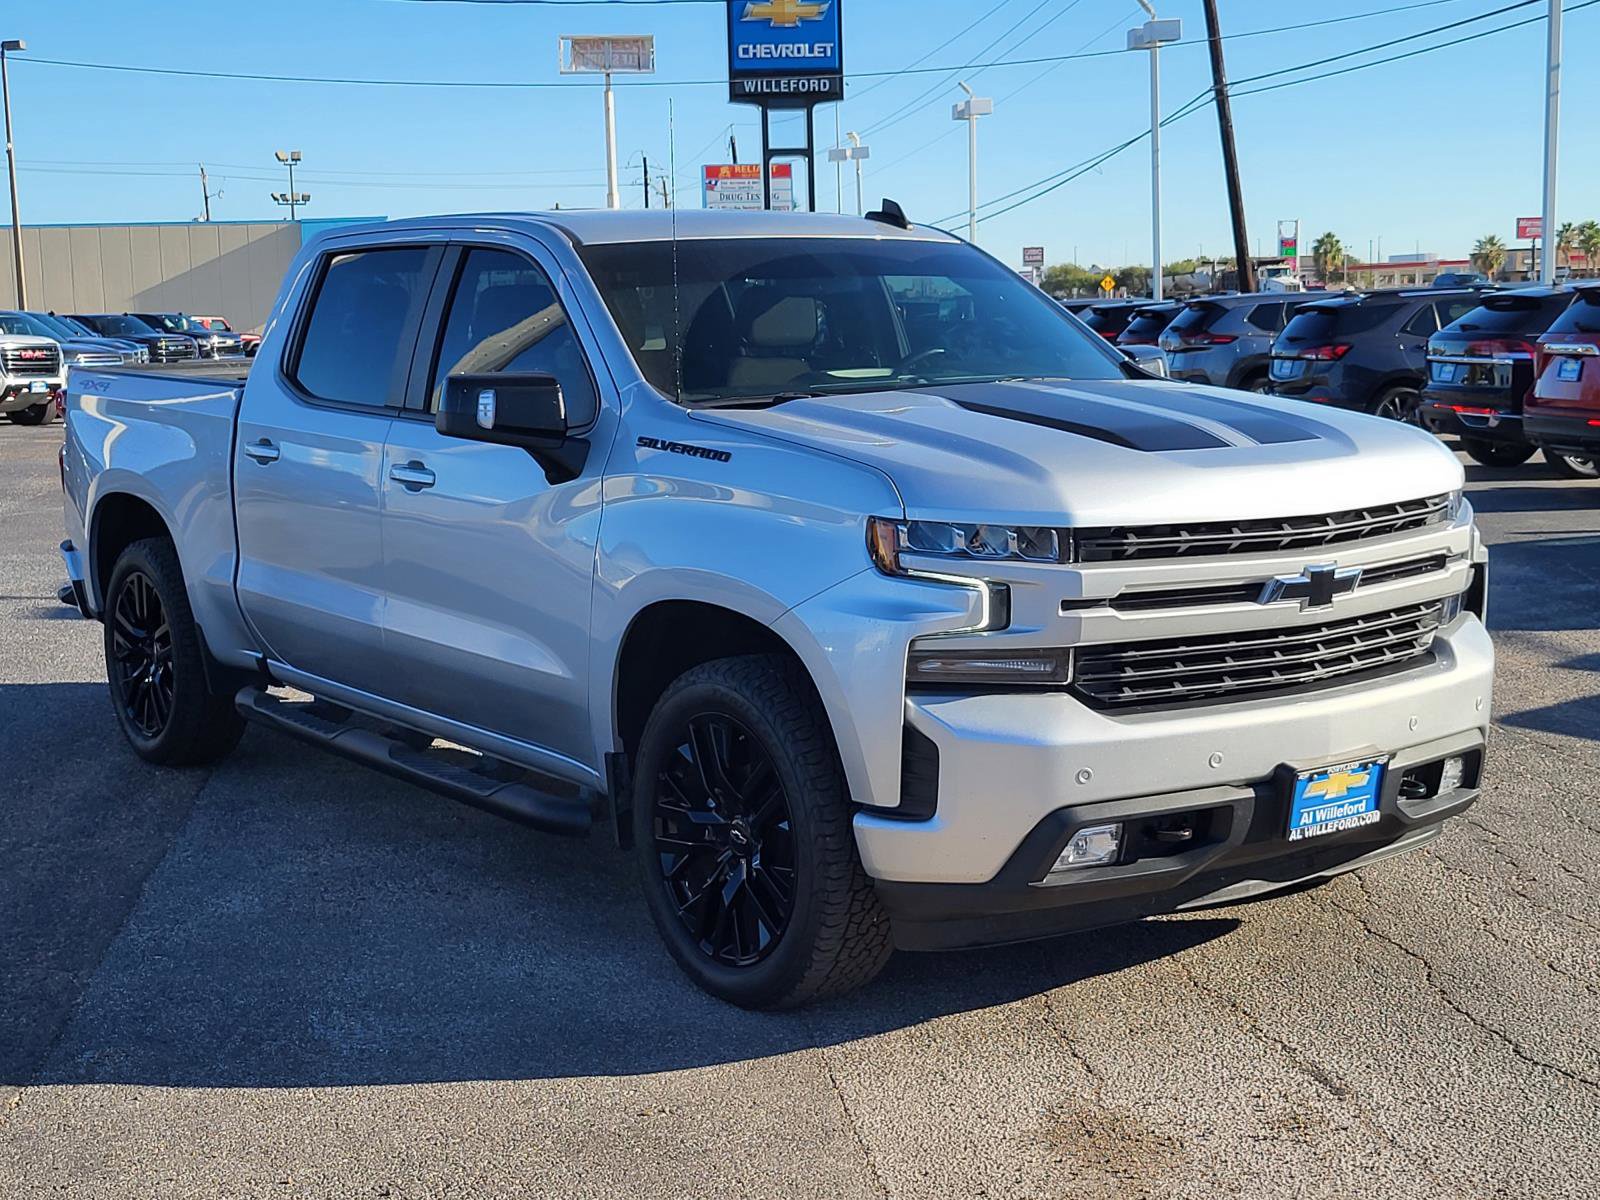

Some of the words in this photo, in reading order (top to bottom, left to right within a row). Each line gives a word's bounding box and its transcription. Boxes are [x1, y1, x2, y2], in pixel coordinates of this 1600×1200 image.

[738, 43, 834, 59] CHEVROLET
[743, 79, 830, 93] WILLEFORD
[734, 165, 778, 174] RELIAT
[719, 193, 743, 202] DRUG
[20, 350, 47, 359] GMC
[636, 436, 732, 463] SILVERADO
[1300, 811, 1314, 826] Al
[1316, 799, 1367, 822] Willeford
[1288, 827, 1303, 842] AL
[1304, 810, 1381, 839] WILLEFORD.COM
